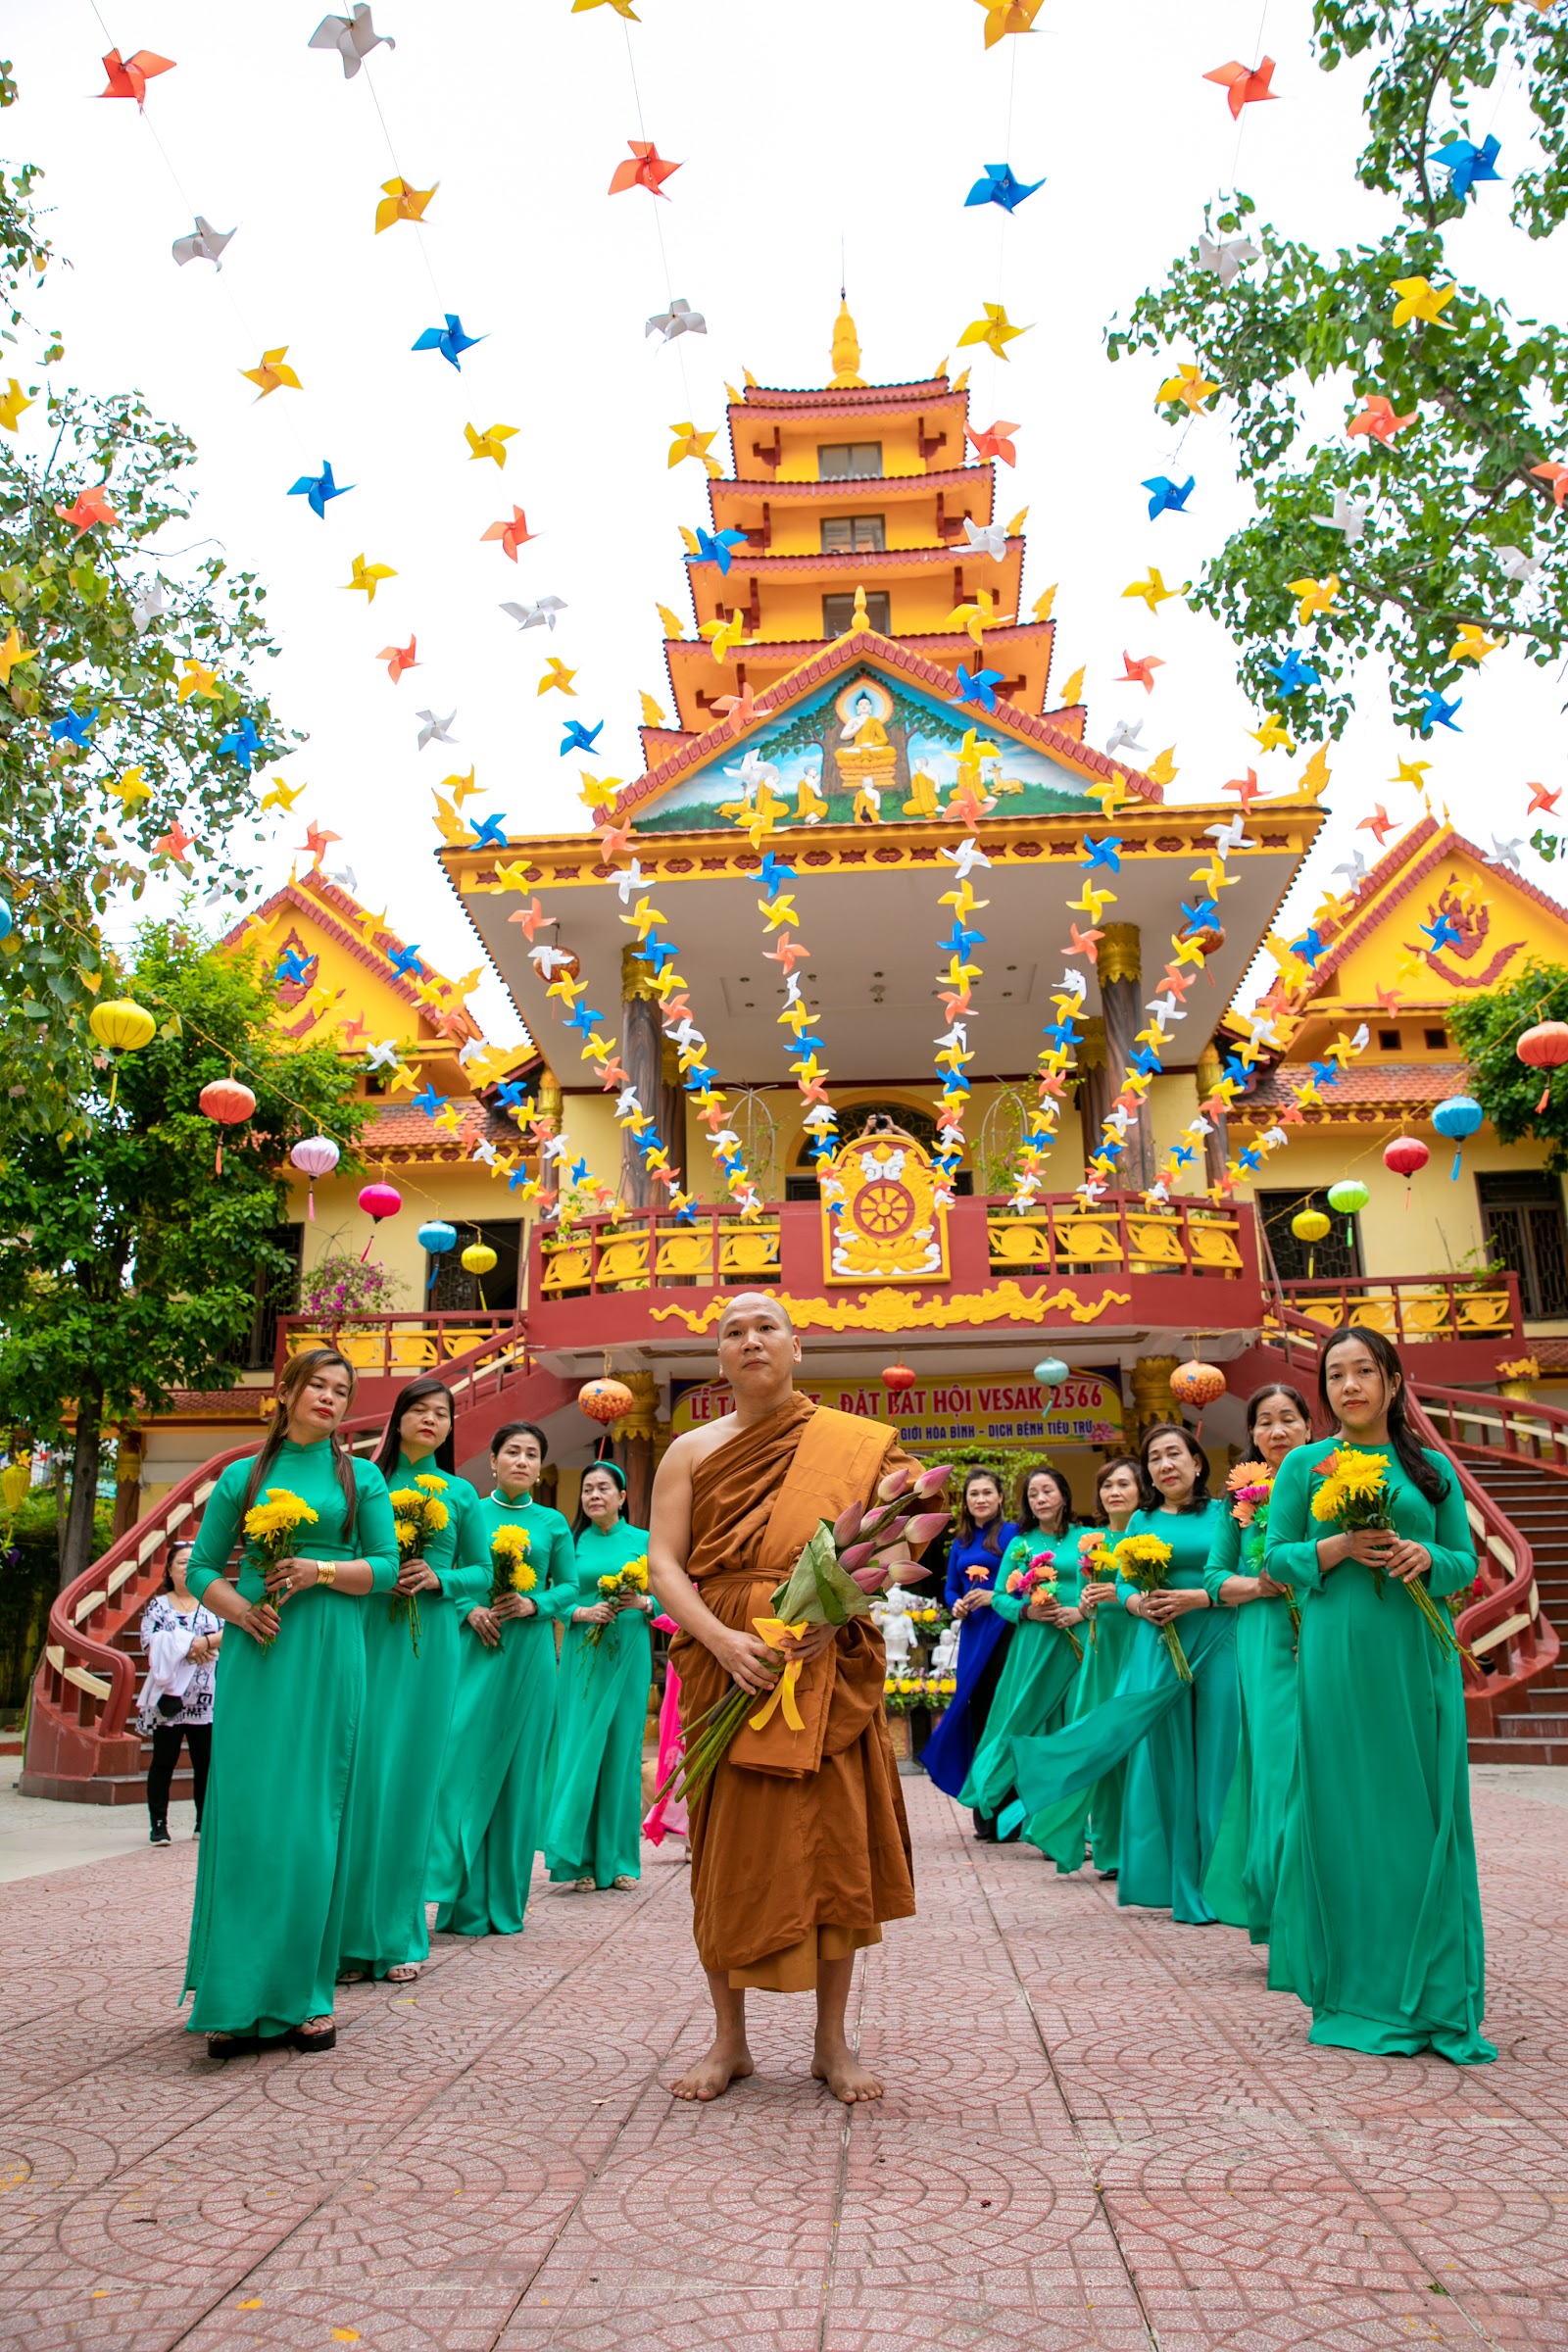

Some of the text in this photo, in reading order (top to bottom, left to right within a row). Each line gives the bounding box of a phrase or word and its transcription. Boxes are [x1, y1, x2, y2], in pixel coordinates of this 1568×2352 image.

[691, 1387, 710, 1420] LỄ
[933, 1384, 972, 1418] HỘI
[977, 1386, 1043, 1412] VESAK
[1052, 1384, 1102, 1409] 2566
[925, 1423, 947, 1440] HÒA
[950, 1422, 975, 1439] BÌNH
[988, 1424, 1013, 1440] DỊCH
[1016, 1421, 1044, 1439] BỆNH
